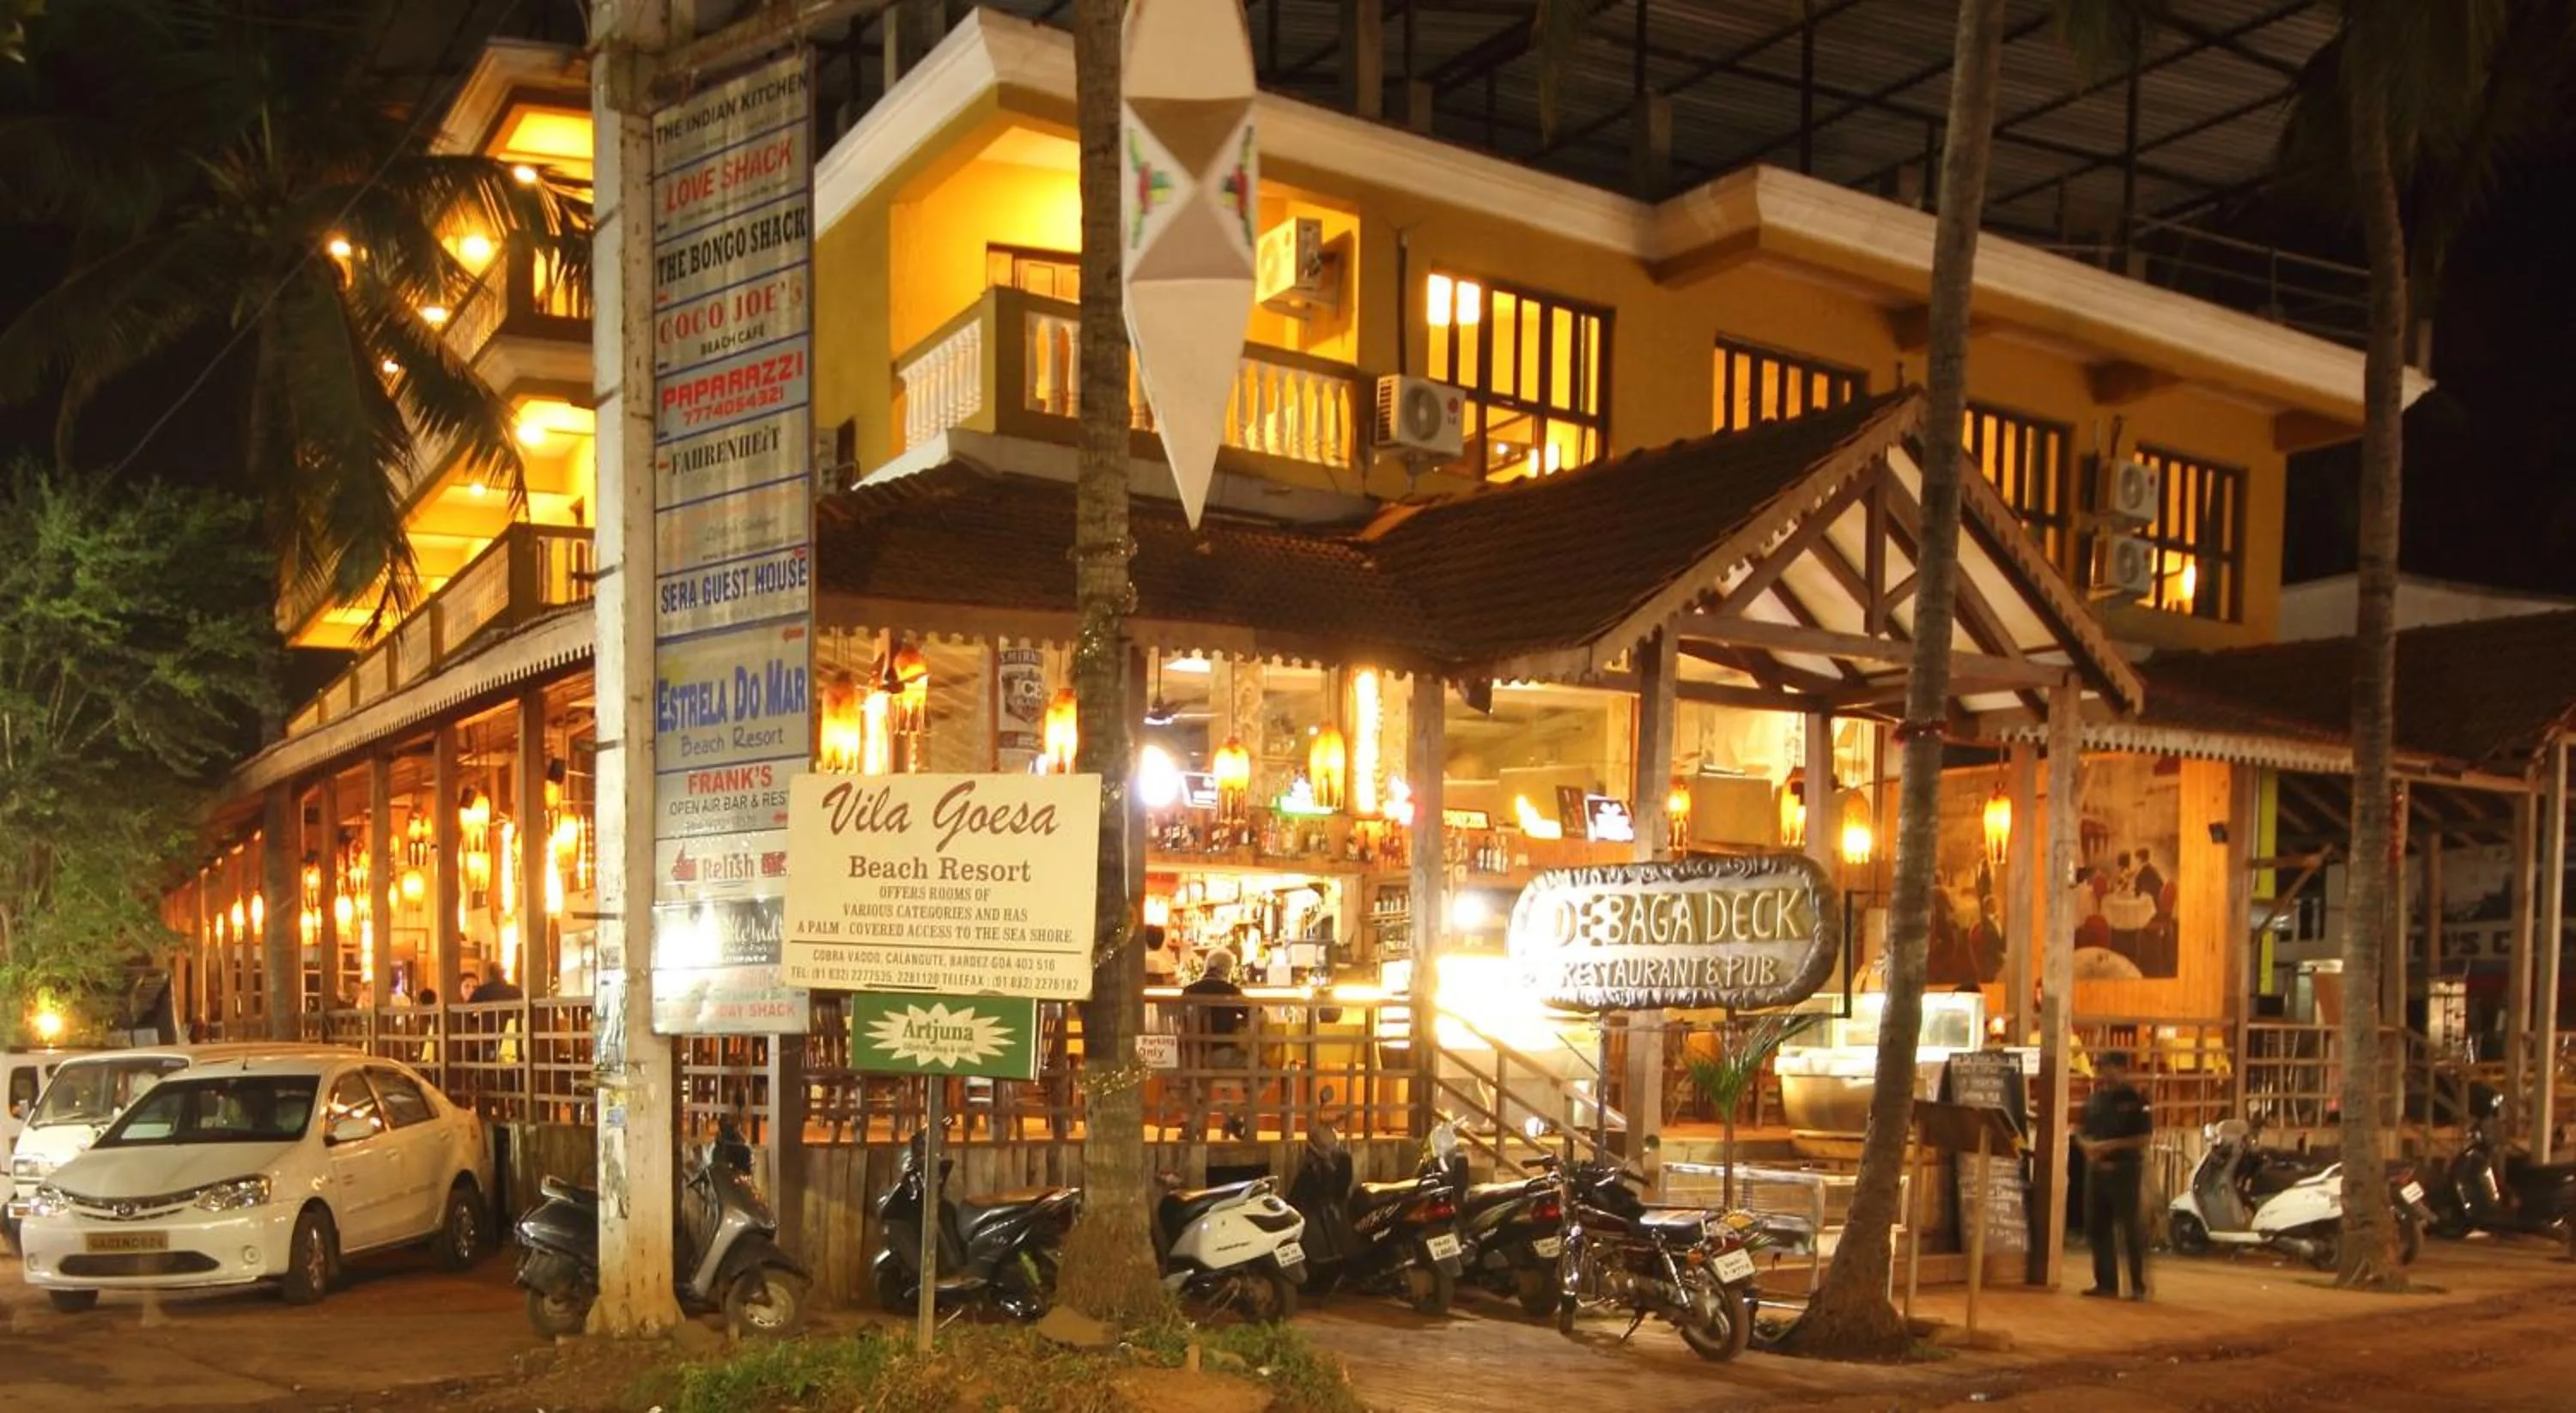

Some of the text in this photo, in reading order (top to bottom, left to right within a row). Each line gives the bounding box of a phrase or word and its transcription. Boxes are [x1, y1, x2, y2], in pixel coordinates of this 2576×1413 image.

[656, 125, 684, 145] THE
[687, 104, 736, 127] INDIAN
[740, 71, 806, 112] KITCHEN
[665, 167, 715, 213] LOVE
[720, 136, 793, 191] SHACK
[657, 208, 806, 286] THE BONGO SHACK
[659, 302, 724, 344] COCO
[700, 334, 736, 356] BEACH
[662, 351, 804, 413] PAPARAZZI
[661, 558, 807, 614] SERA GUEST HOUSE
[681, 727, 784, 757] Beach Resort
[688, 765, 773, 795] FRANK'S
[669, 800, 700, 816] OPEN
[724, 794, 748, 810] BAR
[762, 790, 790, 808] RES
[822, 780, 1060, 853] Vila Goesa
[702, 852, 755, 879] Relish
[848, 856, 1031, 882] Beach Resort
[879, 886, 991, 901] OFFERS ROOMS OF
[843, 904, 1028, 921] VARIOUS CATEGORIES AND HAS
[1706, 888, 1801, 943] DECK
[797, 920, 805, 933] A
[807, 921, 839, 935] PALM
[849, 922, 903, 937] COVERED
[907, 925, 952, 938] ACCESS
[955, 926, 971, 939] TO
[975, 927, 1000, 940] THE
[1003, 928, 1027, 942] SEA
[813, 949, 844, 962] COBRA
[991, 957, 1012, 970] GOA
[1726, 955, 1777, 986] PUB
[902, 1018, 974, 1044] Artjuna
